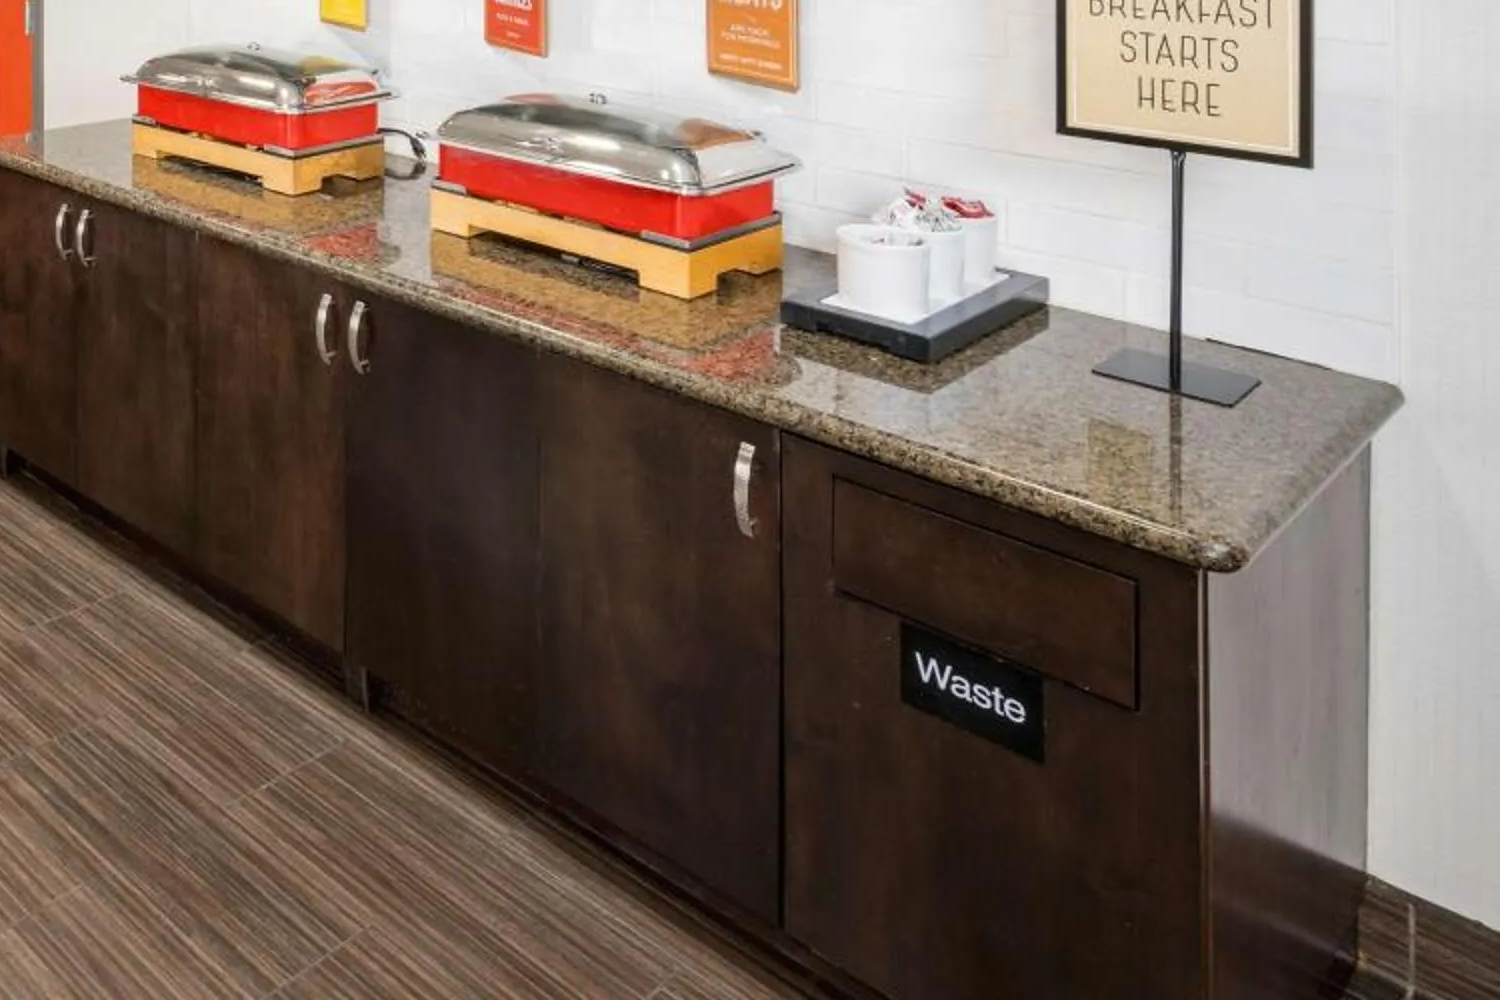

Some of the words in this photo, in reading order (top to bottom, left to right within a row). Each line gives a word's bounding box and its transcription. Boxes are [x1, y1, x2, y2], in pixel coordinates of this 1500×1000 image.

[1120, 30, 1240, 73] STARTS
[1137, 75, 1222, 118] HERE
[914, 651, 1028, 724] Waste
